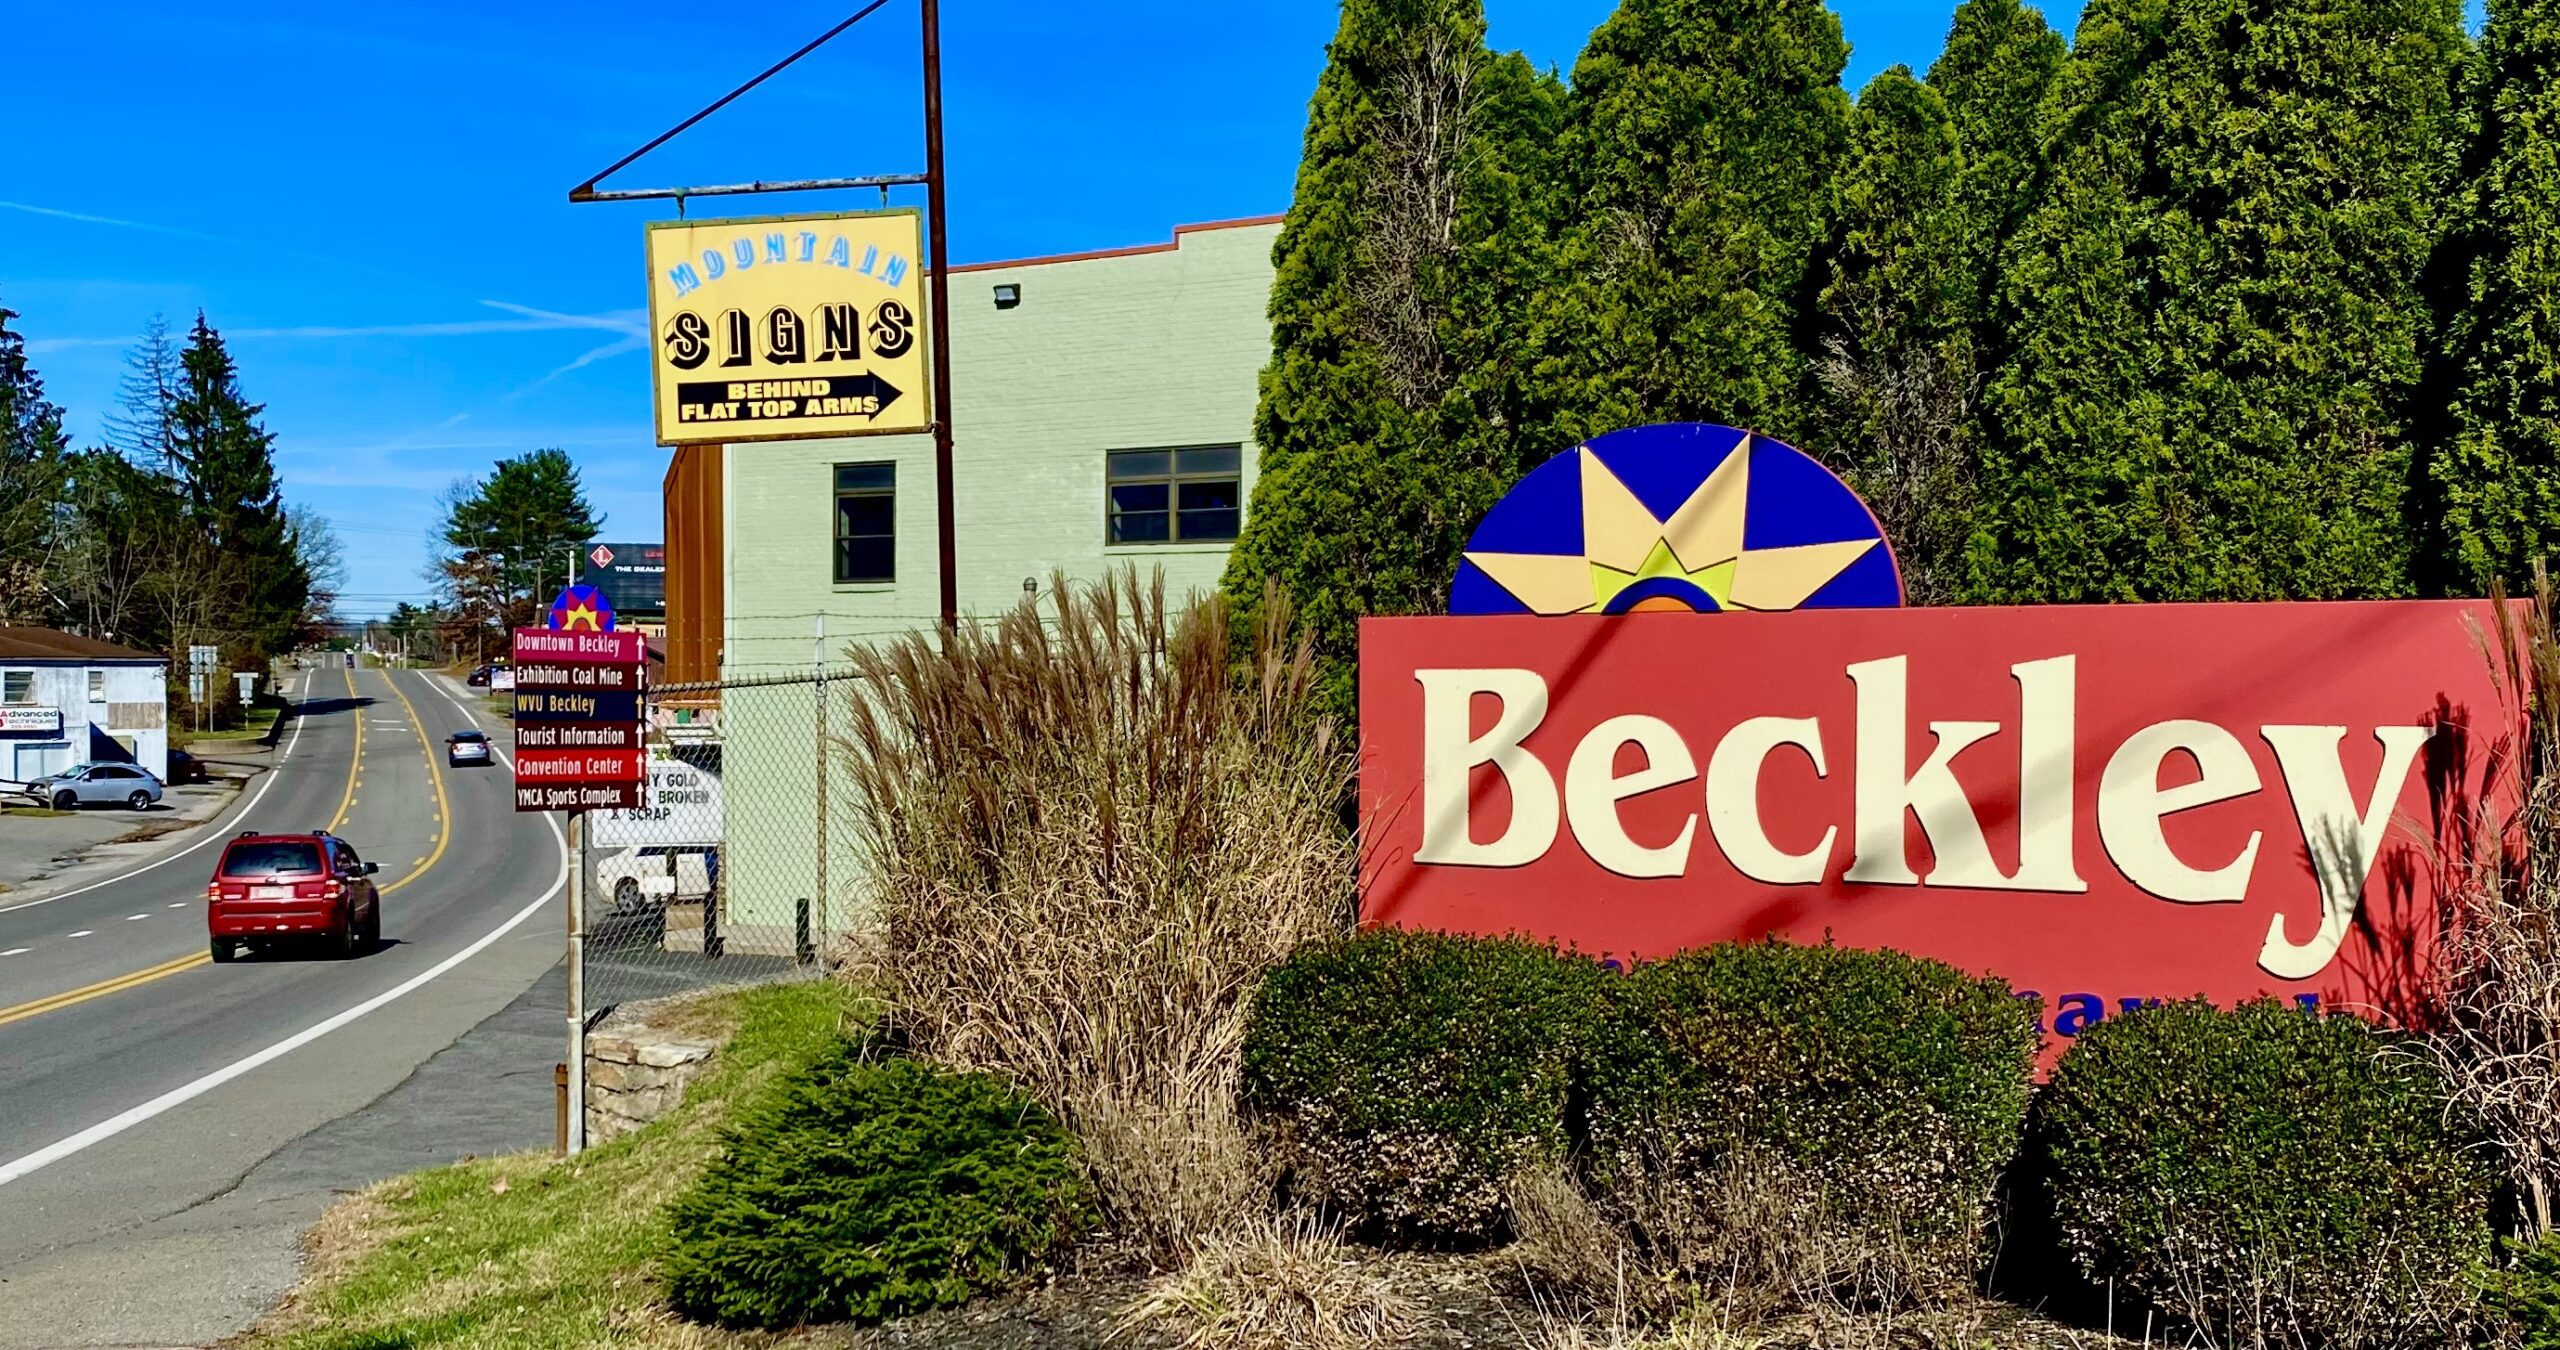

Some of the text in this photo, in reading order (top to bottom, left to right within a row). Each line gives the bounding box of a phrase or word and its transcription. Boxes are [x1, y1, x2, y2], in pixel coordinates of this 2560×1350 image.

[667, 232, 907, 298] MOUNTAIN
[664, 299, 914, 370] SIGNS
[728, 380, 831, 400] BEHIND
[681, 396, 879, 421] FLAT TOP ARMS
[517, 633, 621, 658] Downtown Beckley
[517, 665, 568, 684] Exhibition
[572, 667, 595, 684] Coal
[599, 667, 623, 685] Mine
[0, 710, 57, 718] Advanced
[517, 694, 595, 717] WVU Beckley
[517, 726, 625, 745] Tourist Information
[517, 757, 623, 776] Convention Center
[667, 773, 700, 787] GOLD
[517, 786, 621, 809] YMCA Sports Complex
[659, 790, 709, 804] BROKEN
[629, 807, 671, 820] SCRAP
[1412, 652, 2437, 981] Beckley
